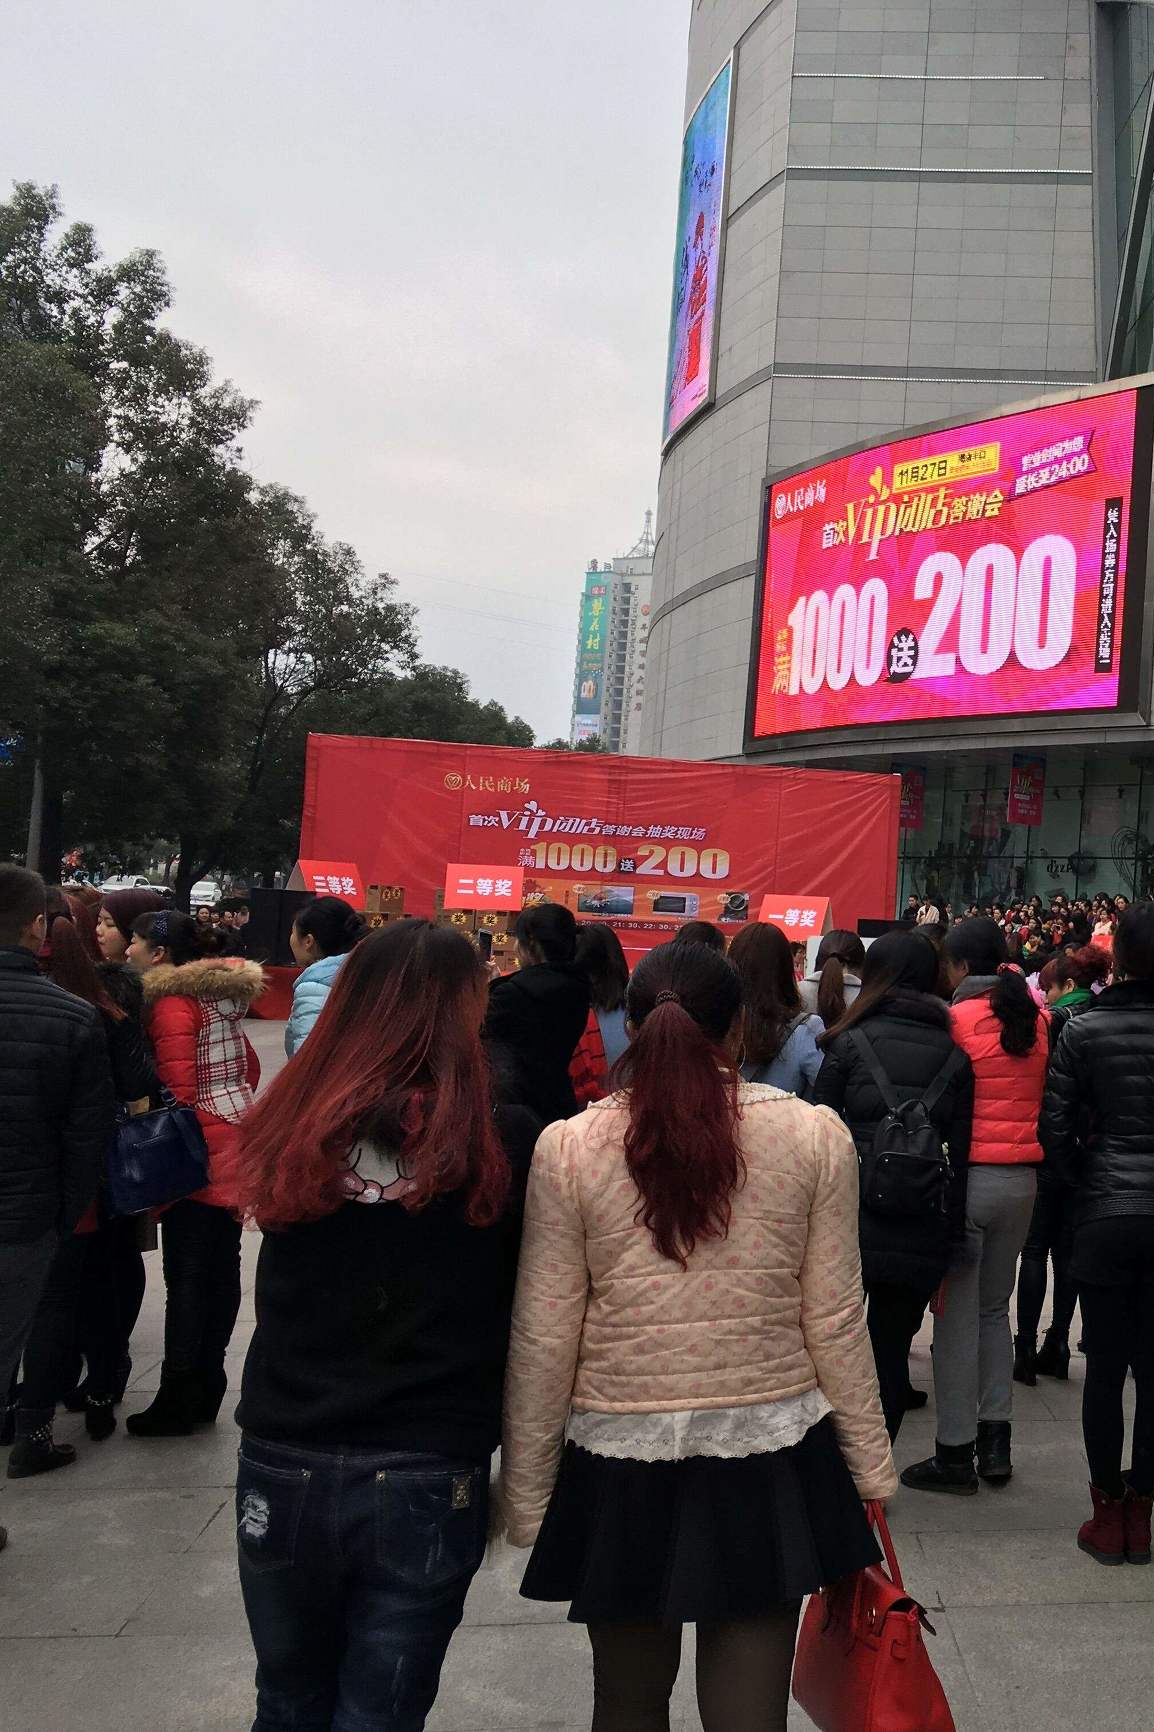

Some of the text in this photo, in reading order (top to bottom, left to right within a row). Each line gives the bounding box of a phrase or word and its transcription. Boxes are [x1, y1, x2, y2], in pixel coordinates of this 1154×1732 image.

[898, 459, 948, 486] 11月27日
[463, 775, 531, 794] 人民商场
[312, 875, 358, 896] 三等奖
[456, 878, 513, 897] 二等奖
[767, 907, 817, 927] 一等奖
